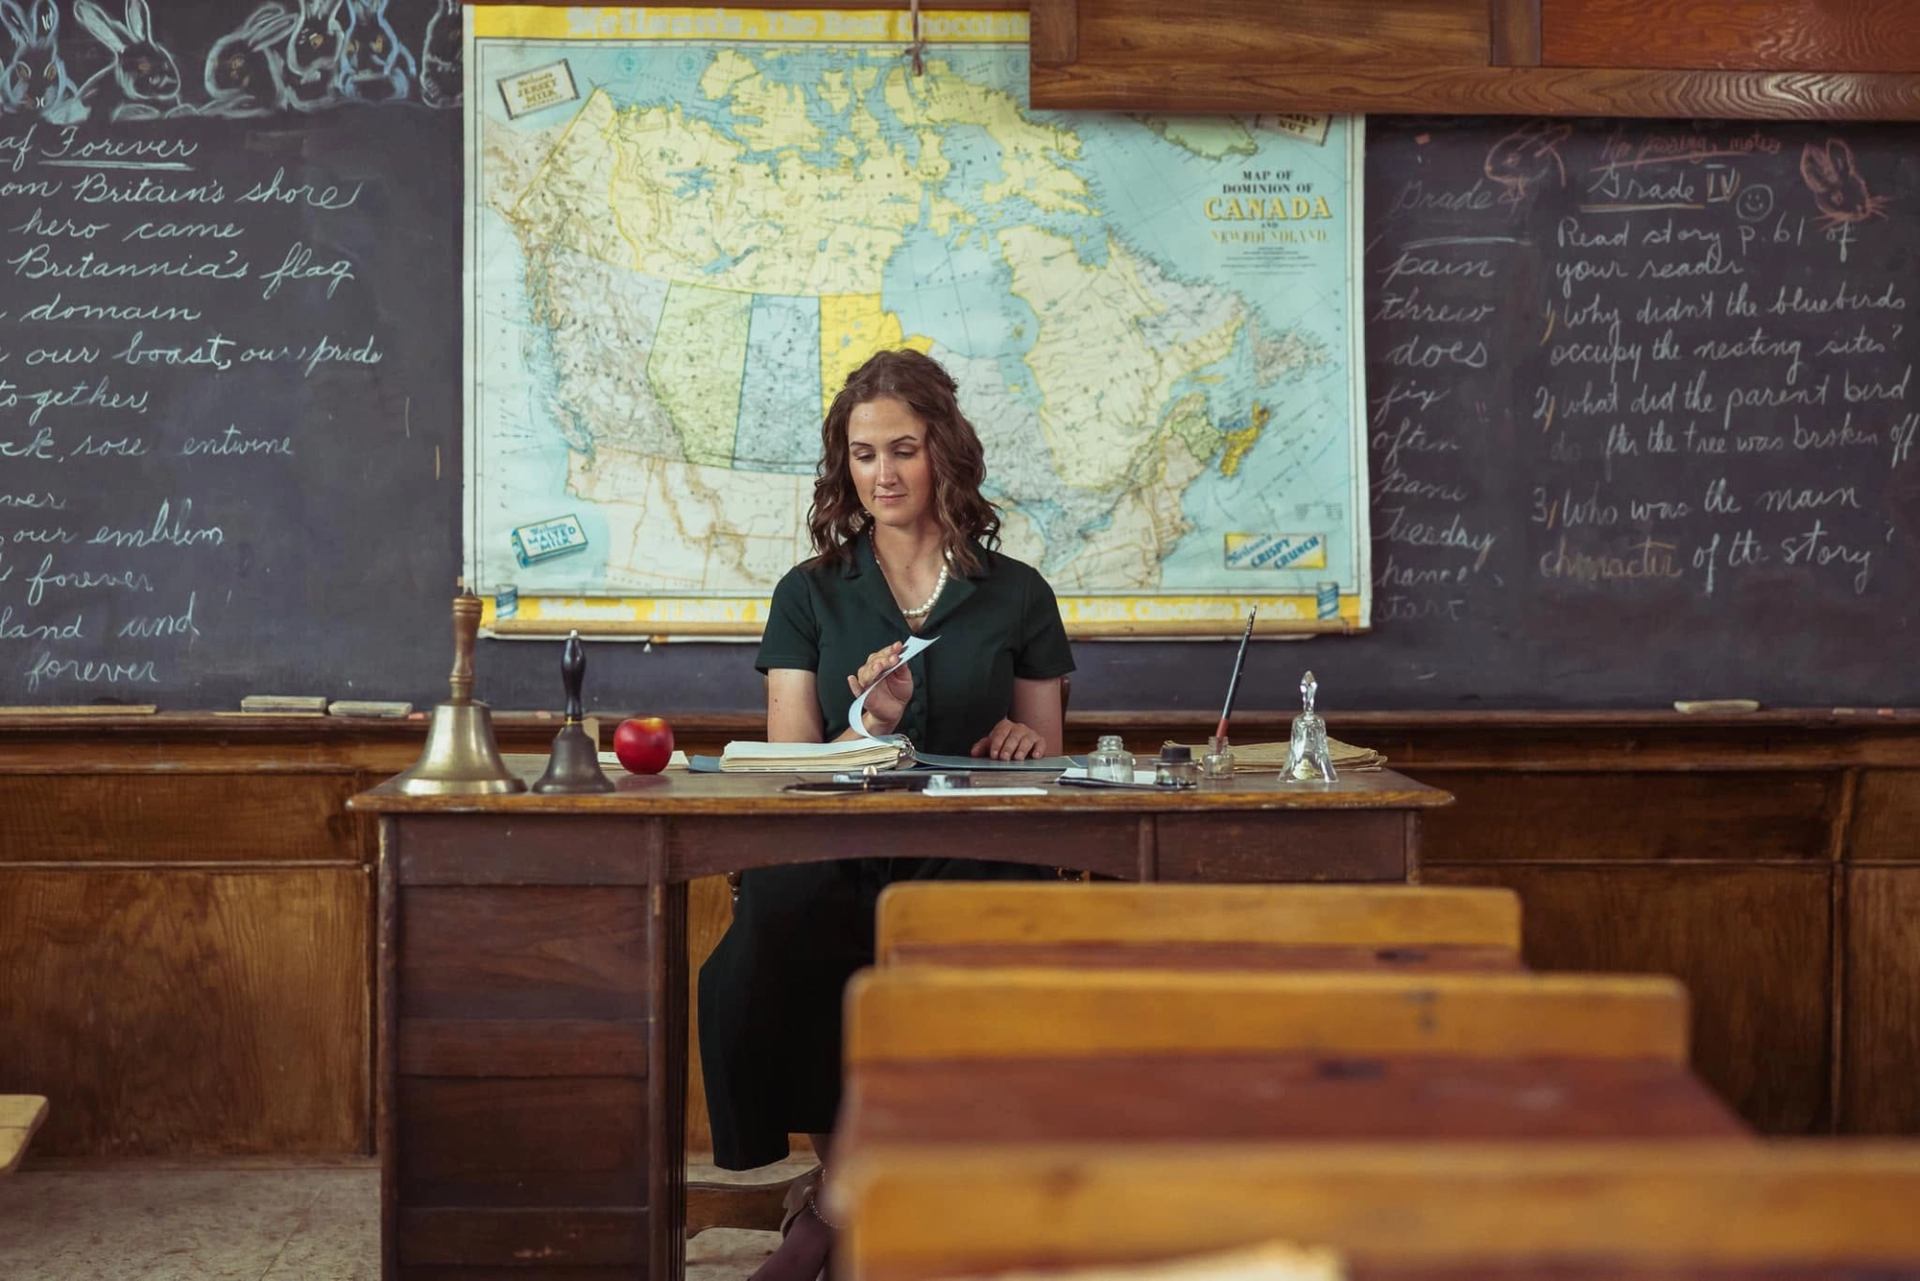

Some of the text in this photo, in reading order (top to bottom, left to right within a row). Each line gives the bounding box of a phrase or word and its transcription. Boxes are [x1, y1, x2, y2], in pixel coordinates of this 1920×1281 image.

[41, 125, 198, 158] Forever
[72, 172, 225, 203] Britain's
[1222, 183, 1315, 194] DOMINION OF
[1242, 170, 1293, 181] MAP OF
[1588, 162, 1695, 202] Grade
[8, 208, 244, 242] hero came
[1203, 195, 1333, 221] CANADA
[1557, 216, 1631, 249] Read
[1640, 217, 1722, 253] story
[7, 242, 354, 299] Britannia's flag
[1556, 258, 1630, 298] your
[19, 293, 201, 323] domain
[1725, 281, 1760, 317] the
[1767, 281, 1907, 316] bluebirds
[26, 350, 101, 365] our
[1386, 336, 1489, 368] does
[1550, 342, 1642, 384] occupy
[1652, 327, 1681, 360] the
[1630, 382, 1677, 415] did
[1684, 369, 1716, 414] the
[1724, 374, 1831, 431] parent
[1843, 363, 1912, 404] bird
[1649, 419, 1678, 453] the
[1736, 430, 1786, 452] was
[1793, 413, 1880, 450] broken
[1631, 494, 1691, 523] was
[1703, 477, 1743, 514] the
[1754, 487, 1862, 514] main
[13, 528, 78, 543] our
[1251, 538, 1291, 568] CRISPY
[1274, 535, 1320, 570] CRUNCH
[1692, 533, 1721, 594] of
[1780, 519, 1872, 594] story
[25, 553, 153, 607] forever
[24, 651, 161, 693] forever
